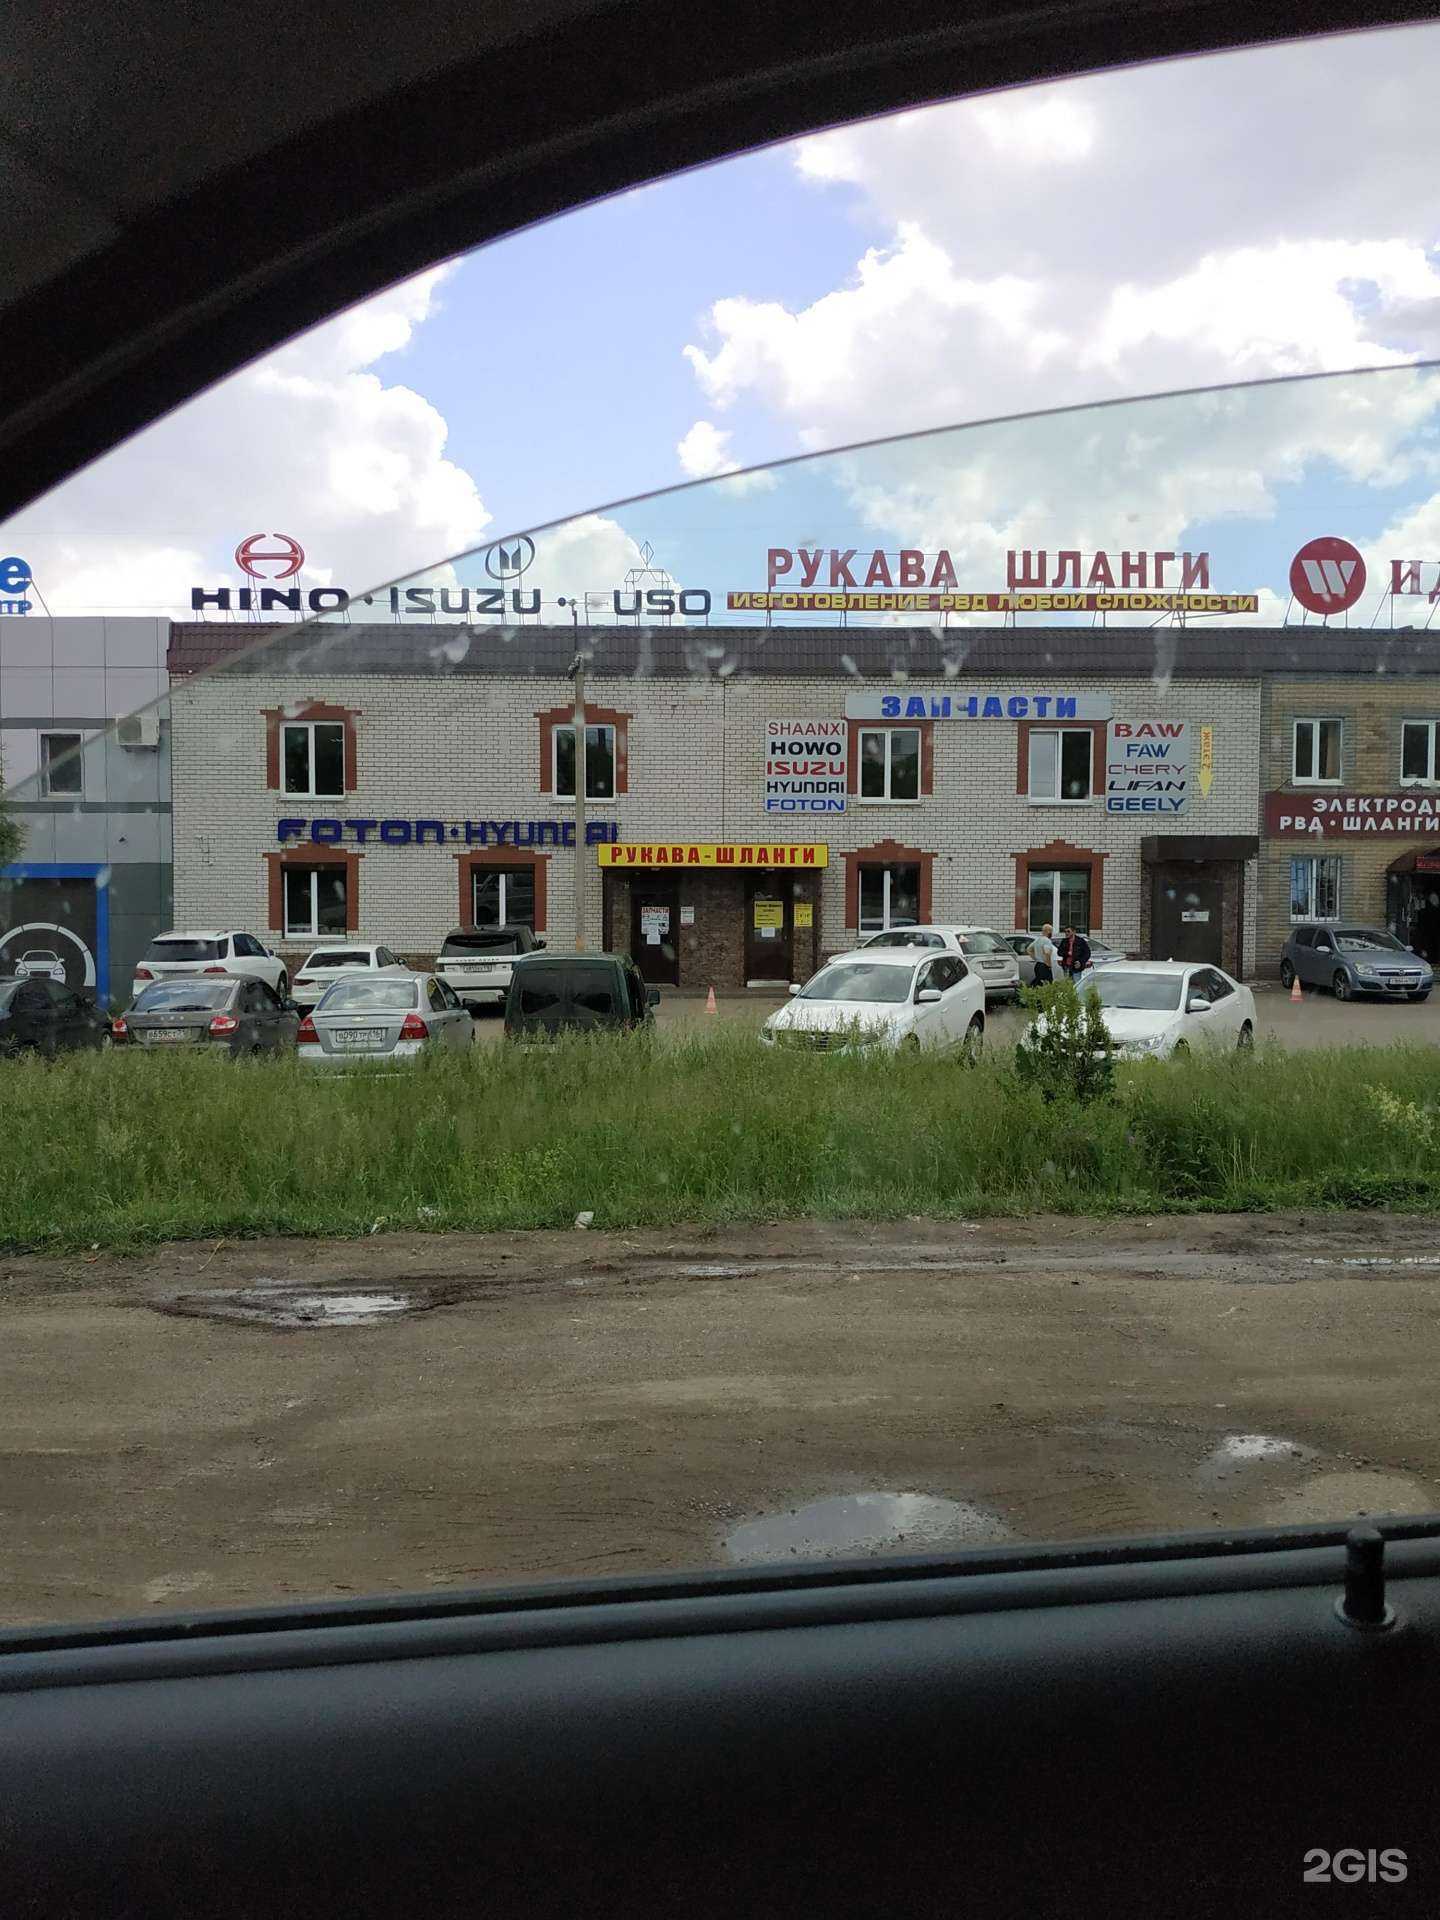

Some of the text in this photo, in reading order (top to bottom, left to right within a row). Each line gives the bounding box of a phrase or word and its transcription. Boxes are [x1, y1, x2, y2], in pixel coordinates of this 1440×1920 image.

[767, 548, 1210, 589] РУКАВА ШЛАНГИ
[1390, 559, 1440, 604] И
[191, 588, 350, 612] HINO
[390, 586, 542, 615] ISUZU
[732, 592, 1256, 612] ИЗГОТОВЛЕНИЕ РВД ЛЮБОЙ СЛОЖНОСТИ
[881, 696, 1078, 719] ЗАПЧАСТИ
[767, 722, 845, 736] SHAANXI
[1114, 723, 1185, 738] BAW
[770, 741, 842, 756] HOWO
[1126, 743, 1171, 758] FAW
[766, 761, 846, 776] ISUZU
[1108, 764, 1187, 775] CHERY
[766, 781, 845, 794] HYUNDAI
[1107, 780, 1187, 791] LIFAN
[766, 798, 846, 811] FOTON
[1107, 797, 1187, 811] GEELY
[1279, 816, 1440, 833] РВД ШЛАНГИ
